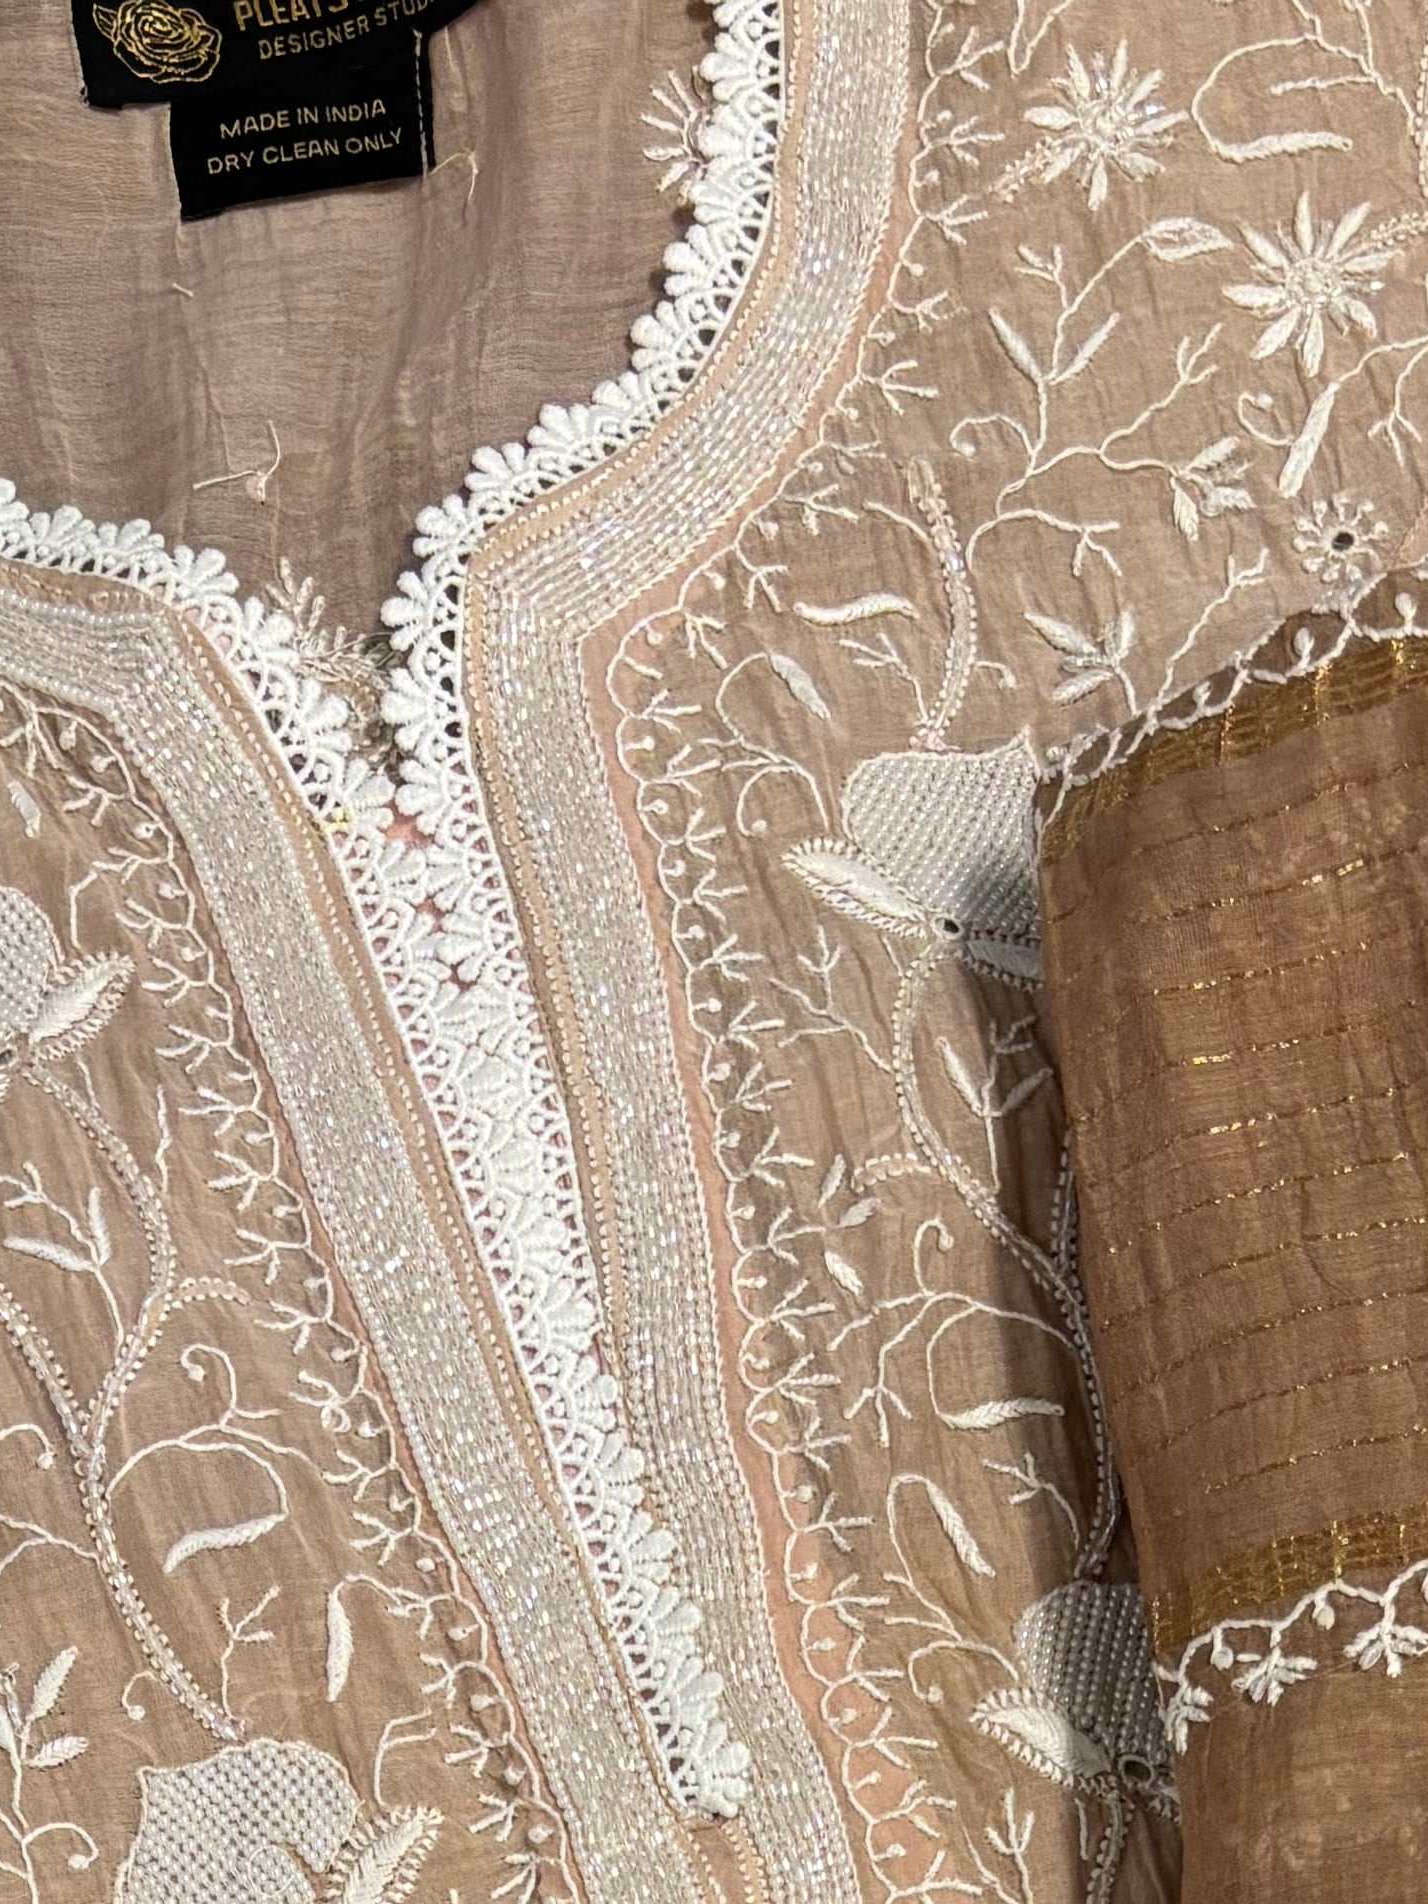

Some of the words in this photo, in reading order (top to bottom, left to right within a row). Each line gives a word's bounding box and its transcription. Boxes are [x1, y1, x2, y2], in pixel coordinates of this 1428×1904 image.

[258, 15, 370, 60] DESIGNER
[219, 110, 291, 140] MADE
[297, 106, 320, 126] IN
[326, 98, 387, 124] INDIA
[207, 150, 255, 175] DRY
[262, 139, 340, 165] CLEAN
[345, 127, 402, 155] ONLY
